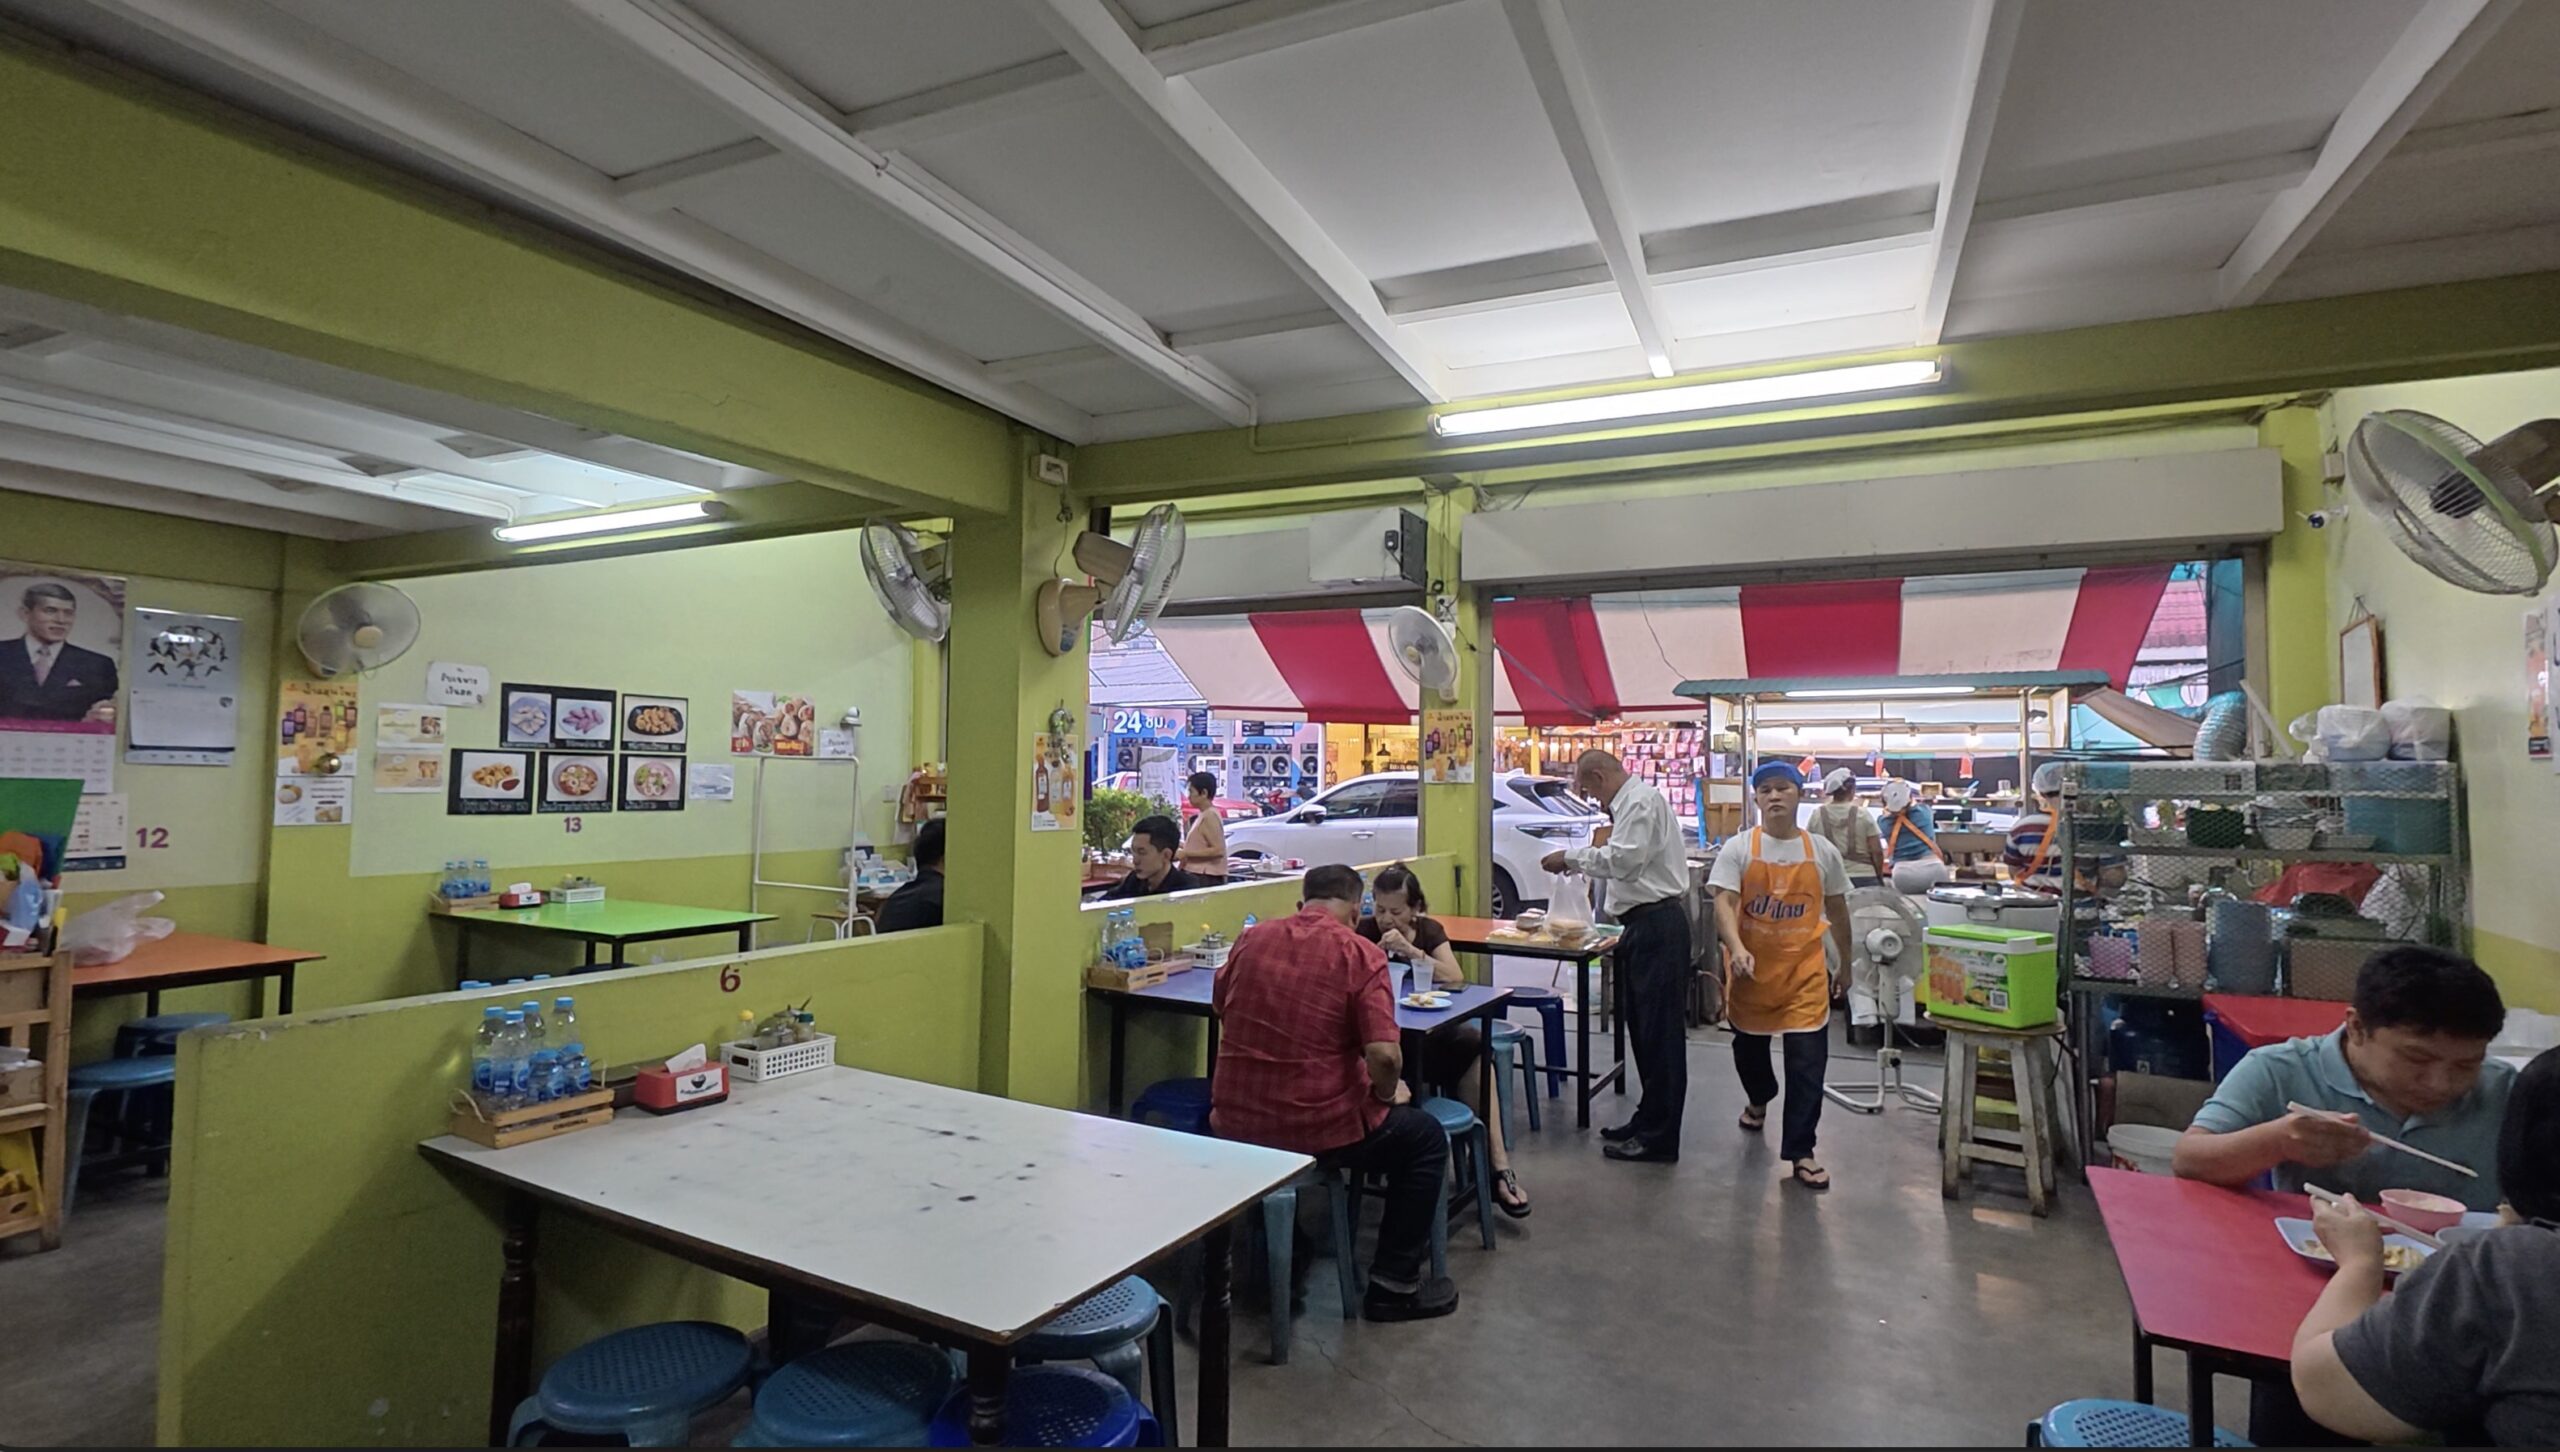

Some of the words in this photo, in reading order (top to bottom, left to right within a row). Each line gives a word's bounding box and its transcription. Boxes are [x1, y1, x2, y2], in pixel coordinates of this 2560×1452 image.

[1113, 710, 1142, 734] 24
[1145, 716, 1168, 729] ชม.
[563, 816, 582, 833] 13
[136, 827, 170, 849] 12
[720, 963, 742, 993] 6
